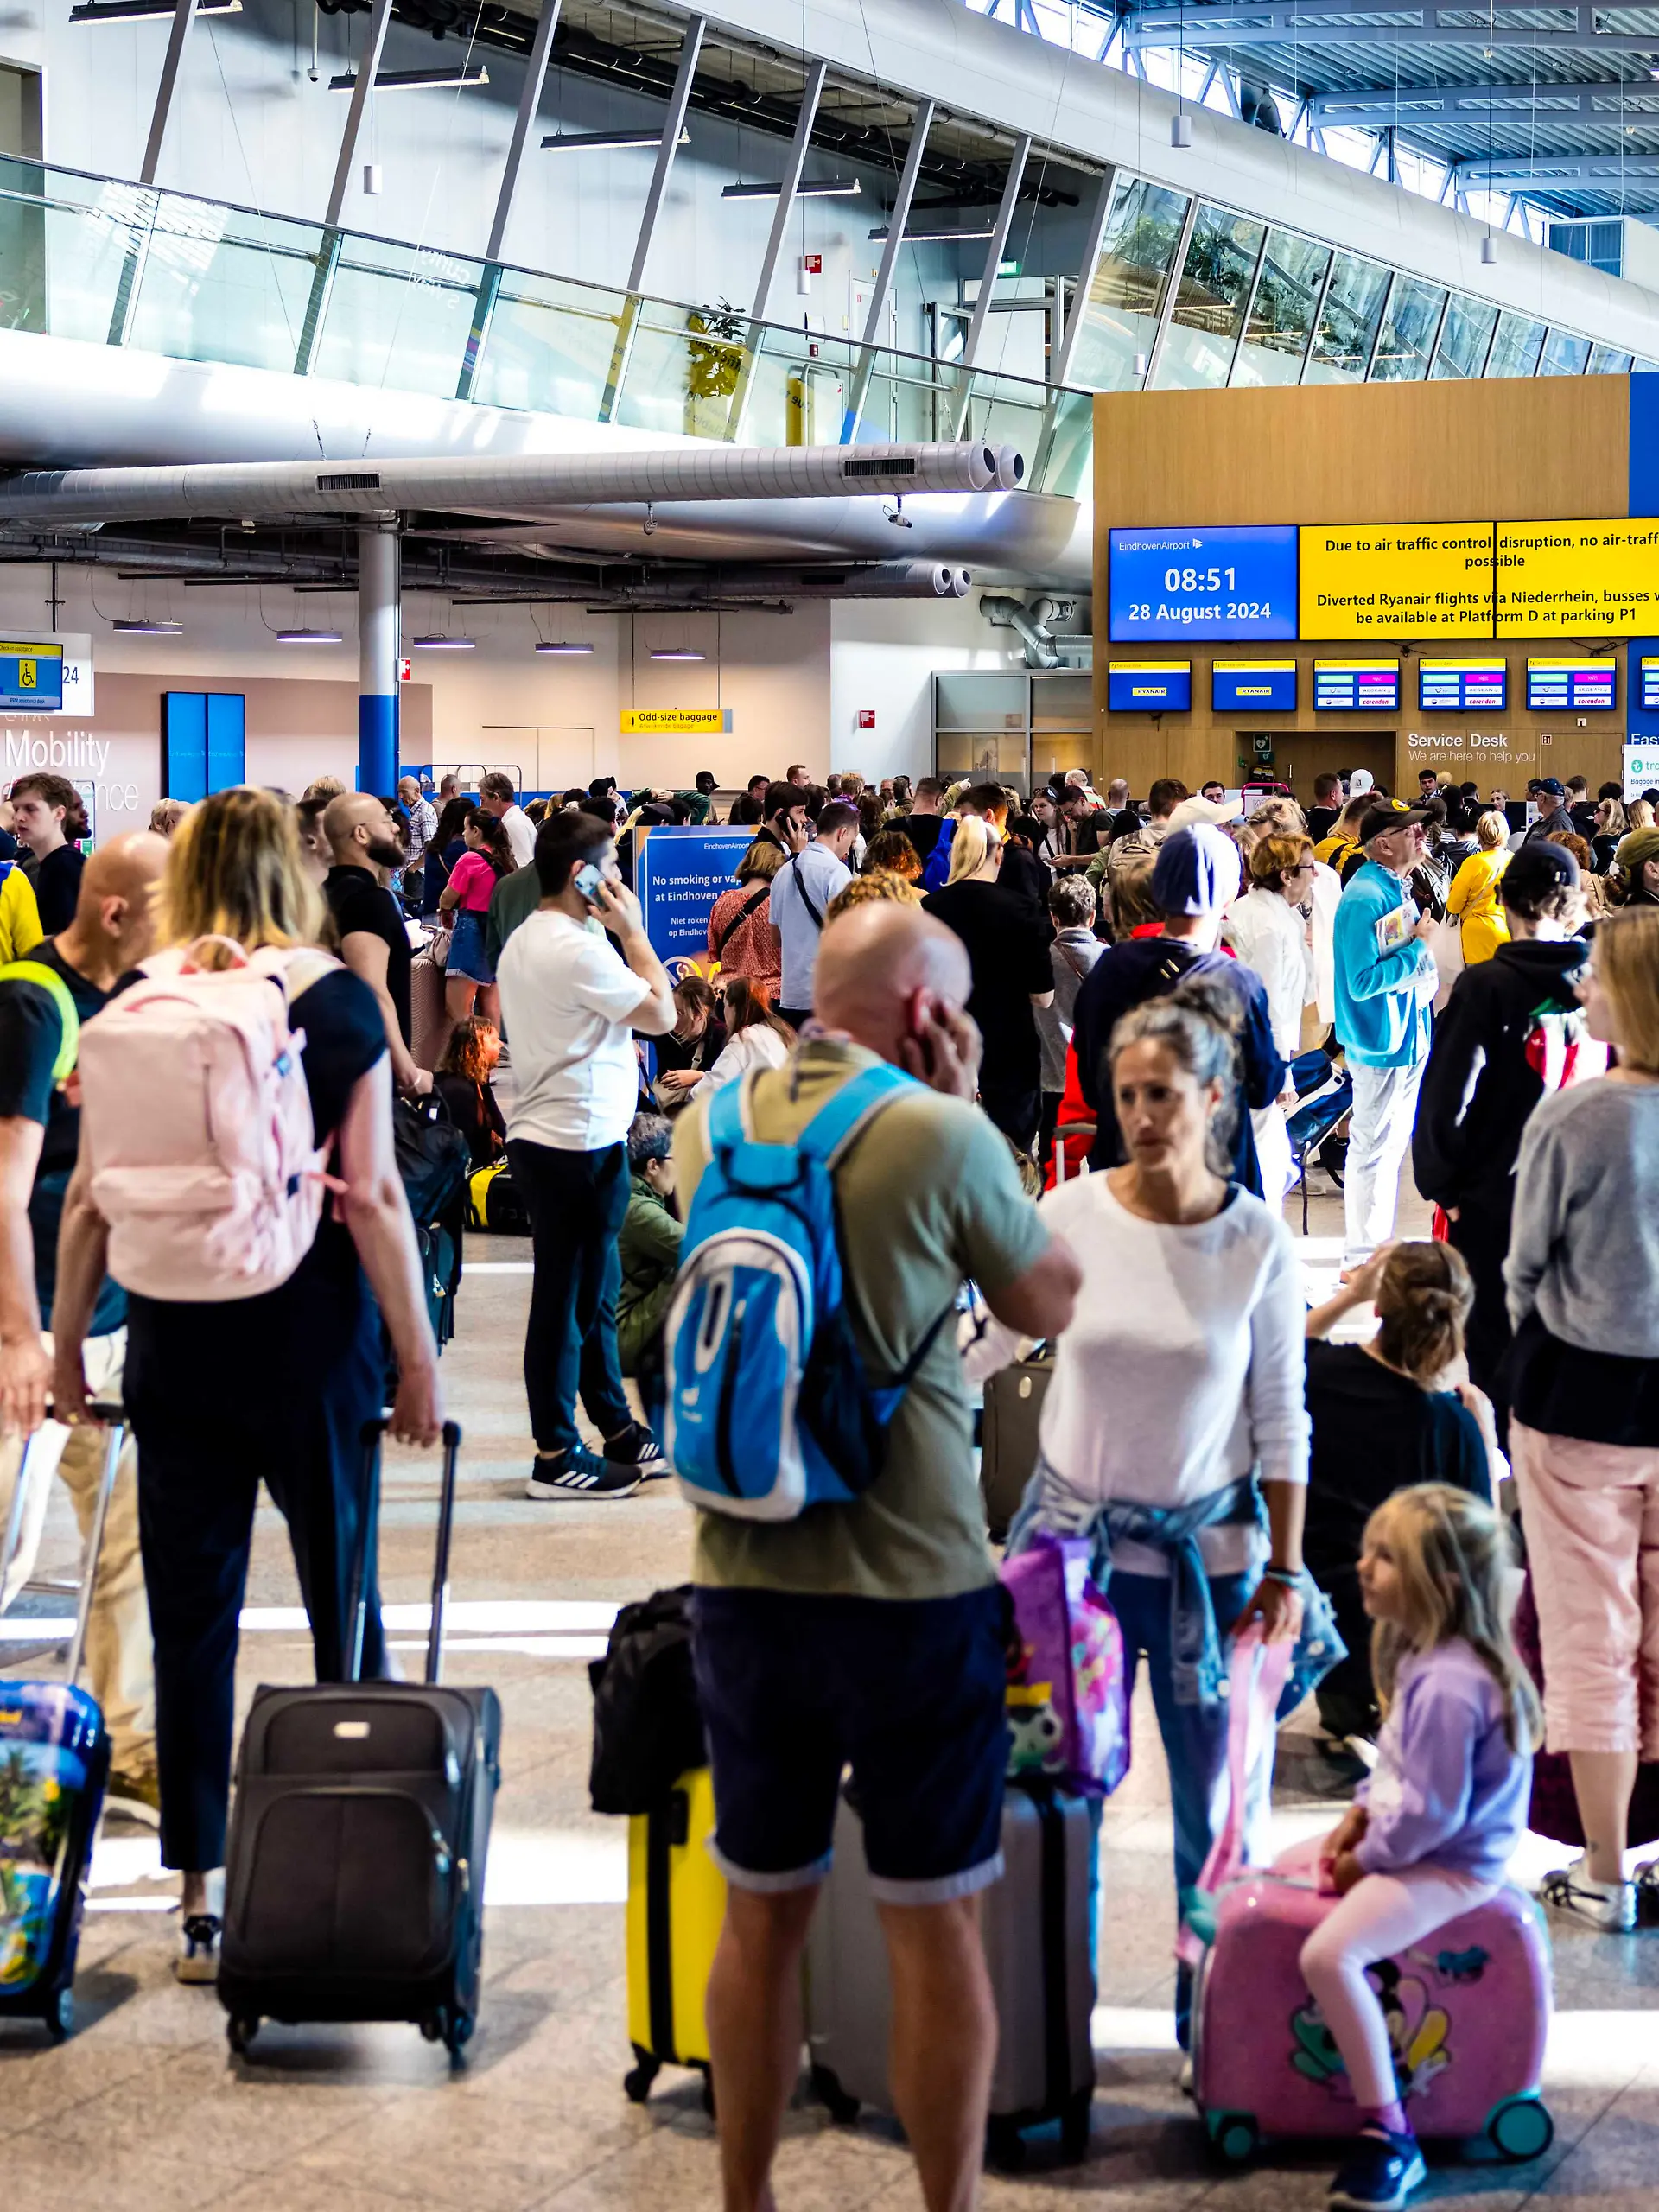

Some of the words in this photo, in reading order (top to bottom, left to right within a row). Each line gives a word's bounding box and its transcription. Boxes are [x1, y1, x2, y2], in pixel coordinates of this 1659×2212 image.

[1119, 542, 1190, 551] EindhovenAirport
[1325, 540, 1352, 551] Due
[1357, 540, 1370, 551] to
[1374, 538, 1392, 550] air
[1396, 537, 1438, 550] traffic
[1442, 536, 1491, 549] control
[1499, 535, 1575, 550] disruption,
[1580, 537, 1598, 546] no
[1465, 554, 1525, 570] possible
[1164, 567, 1235, 592] 08:51
[1317, 593, 1375, 606] Diverted
[1379, 592, 1432, 608] Ryanair
[1434, 591, 1479, 607] flights
[1511, 590, 1599, 604] Niederrhein,
[1603, 589, 1650, 602] busses
[1128, 603, 1151, 620] 28
[1155, 603, 1222, 624] August
[1225, 602, 1272, 620] 2024
[1356, 611, 1373, 623] be
[1376, 610, 1437, 623] available
[1440, 612, 1455, 623] at
[1459, 610, 1523, 623] Platform
[1528, 609, 1539, 622] D
[1542, 610, 1557, 622] at
[1560, 608, 1615, 624] parking
[1619, 607, 1637, 620] P1
[62, 665, 79, 684] 24
[639, 712, 677, 721] Odd-size
[679, 713, 718, 723] baggage
[1408, 733, 1463, 748] Service
[1470, 734, 1508, 747] Desk
[4, 729, 110, 776] Mobility
[1408, 750, 1427, 761] We
[1429, 751, 1447, 761] are
[1449, 750, 1473, 761] here
[1476, 751, 1487, 761] to
[1489, 750, 1512, 763] help
[1515, 752, 1535, 763] you
[1630, 778, 1653, 786] Bagage
[652, 875, 667, 886] No
[669, 874, 710, 887] smoking
[654, 893, 665, 902] at
[667, 891, 718, 902] Eindhoven
[671, 917, 686, 925] Niet
[678, 928, 708, 937] Eindhov
